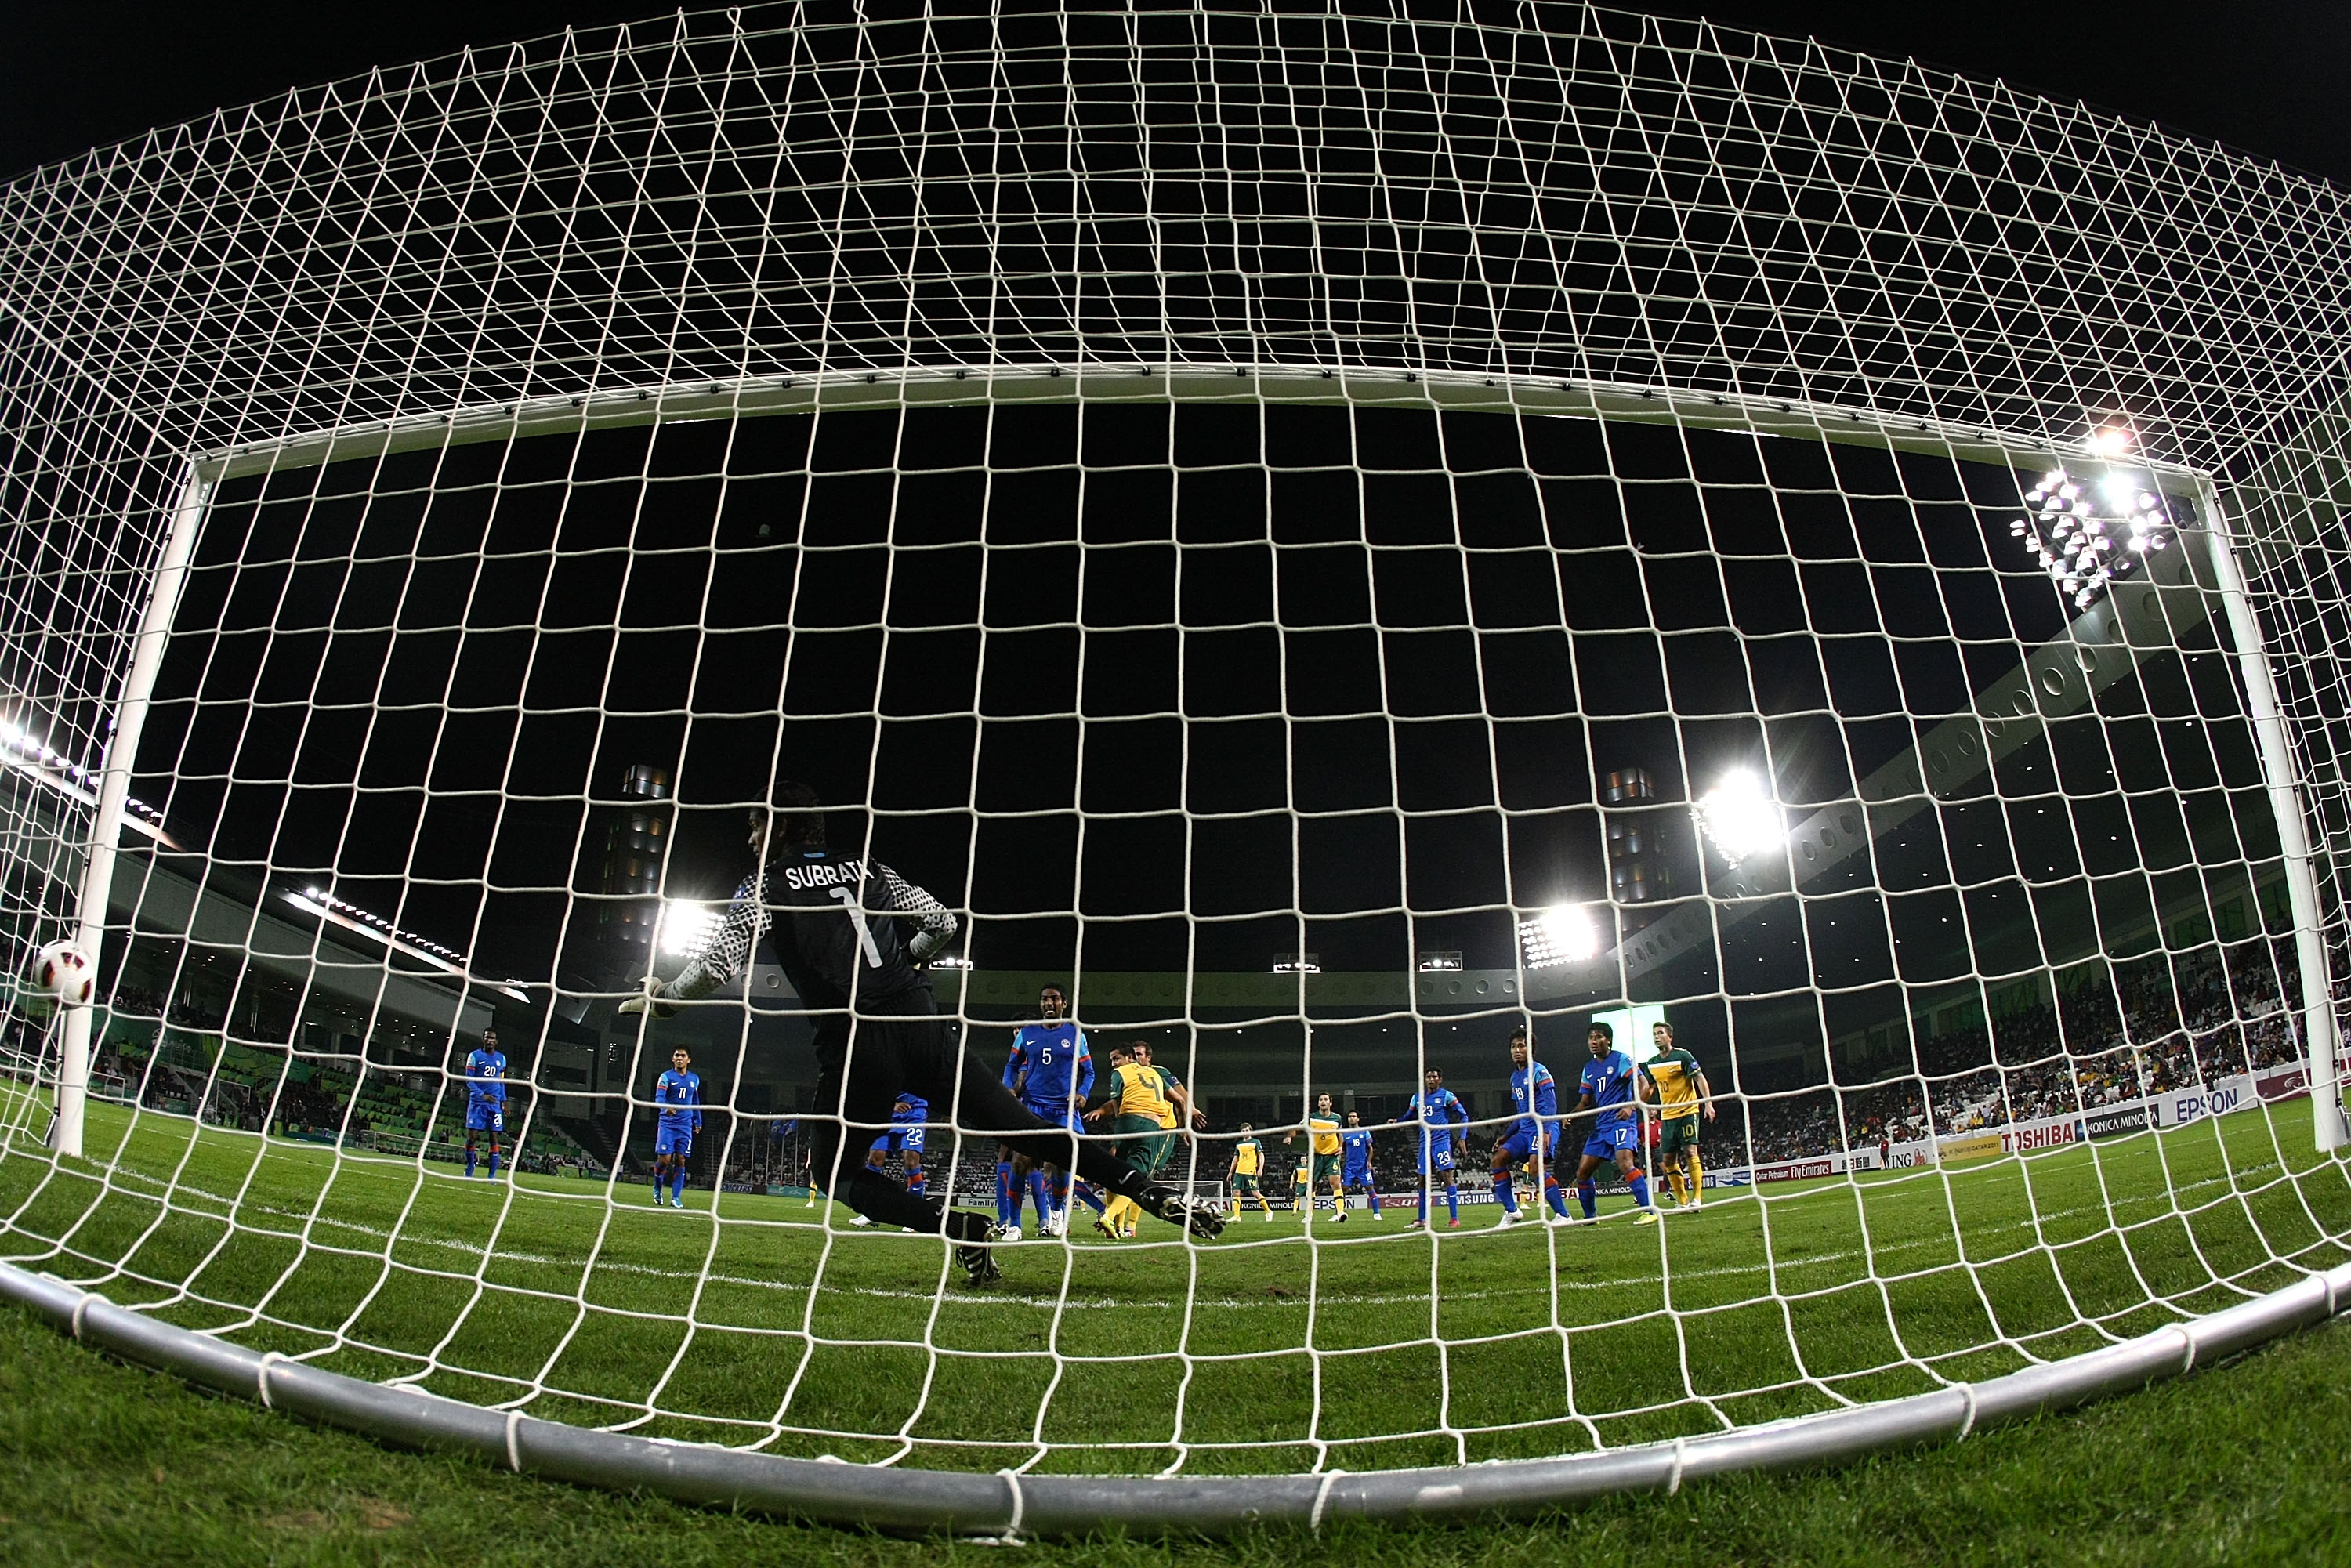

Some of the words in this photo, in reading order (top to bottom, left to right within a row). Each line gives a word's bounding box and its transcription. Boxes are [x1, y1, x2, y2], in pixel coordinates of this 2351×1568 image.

[785, 860, 875, 890] SUBRATA
[828, 886, 883, 969] 1
[1041, 1048, 1052, 1065] 5
[484, 1066, 497, 1077] 20
[1136, 1073, 1161, 1102] 4
[1597, 1076, 1607, 1093] 17
[1660, 1081, 1670, 1094] 10
[679, 1087, 686, 1099] 11
[1515, 1087, 1524, 1100] 19
[2176, 1088, 2238, 1122] EPSON
[2087, 1119, 2120, 1134] KONICA
[2119, 1110, 2159, 1128] MINOLTA
[906, 1127, 922, 1143] 22
[1615, 1128, 1628, 1142] 17
[1681, 1124, 1694, 1137] 10
[2001, 1123, 2074, 1152] TOSHIBA
[1353, 1138, 1360, 1146] 16
[1436, 1150, 1451, 1164] 23
[1891, 1153, 1911, 1168] ING
[1332, 1161, 1339, 1170] 6
[1791, 1166, 1801, 1179] Fly
[1801, 1163, 1829, 1177] Emirates
[1755, 1171, 1768, 1182] Qatar
[721, 1182, 753, 1193] SNICKERS
